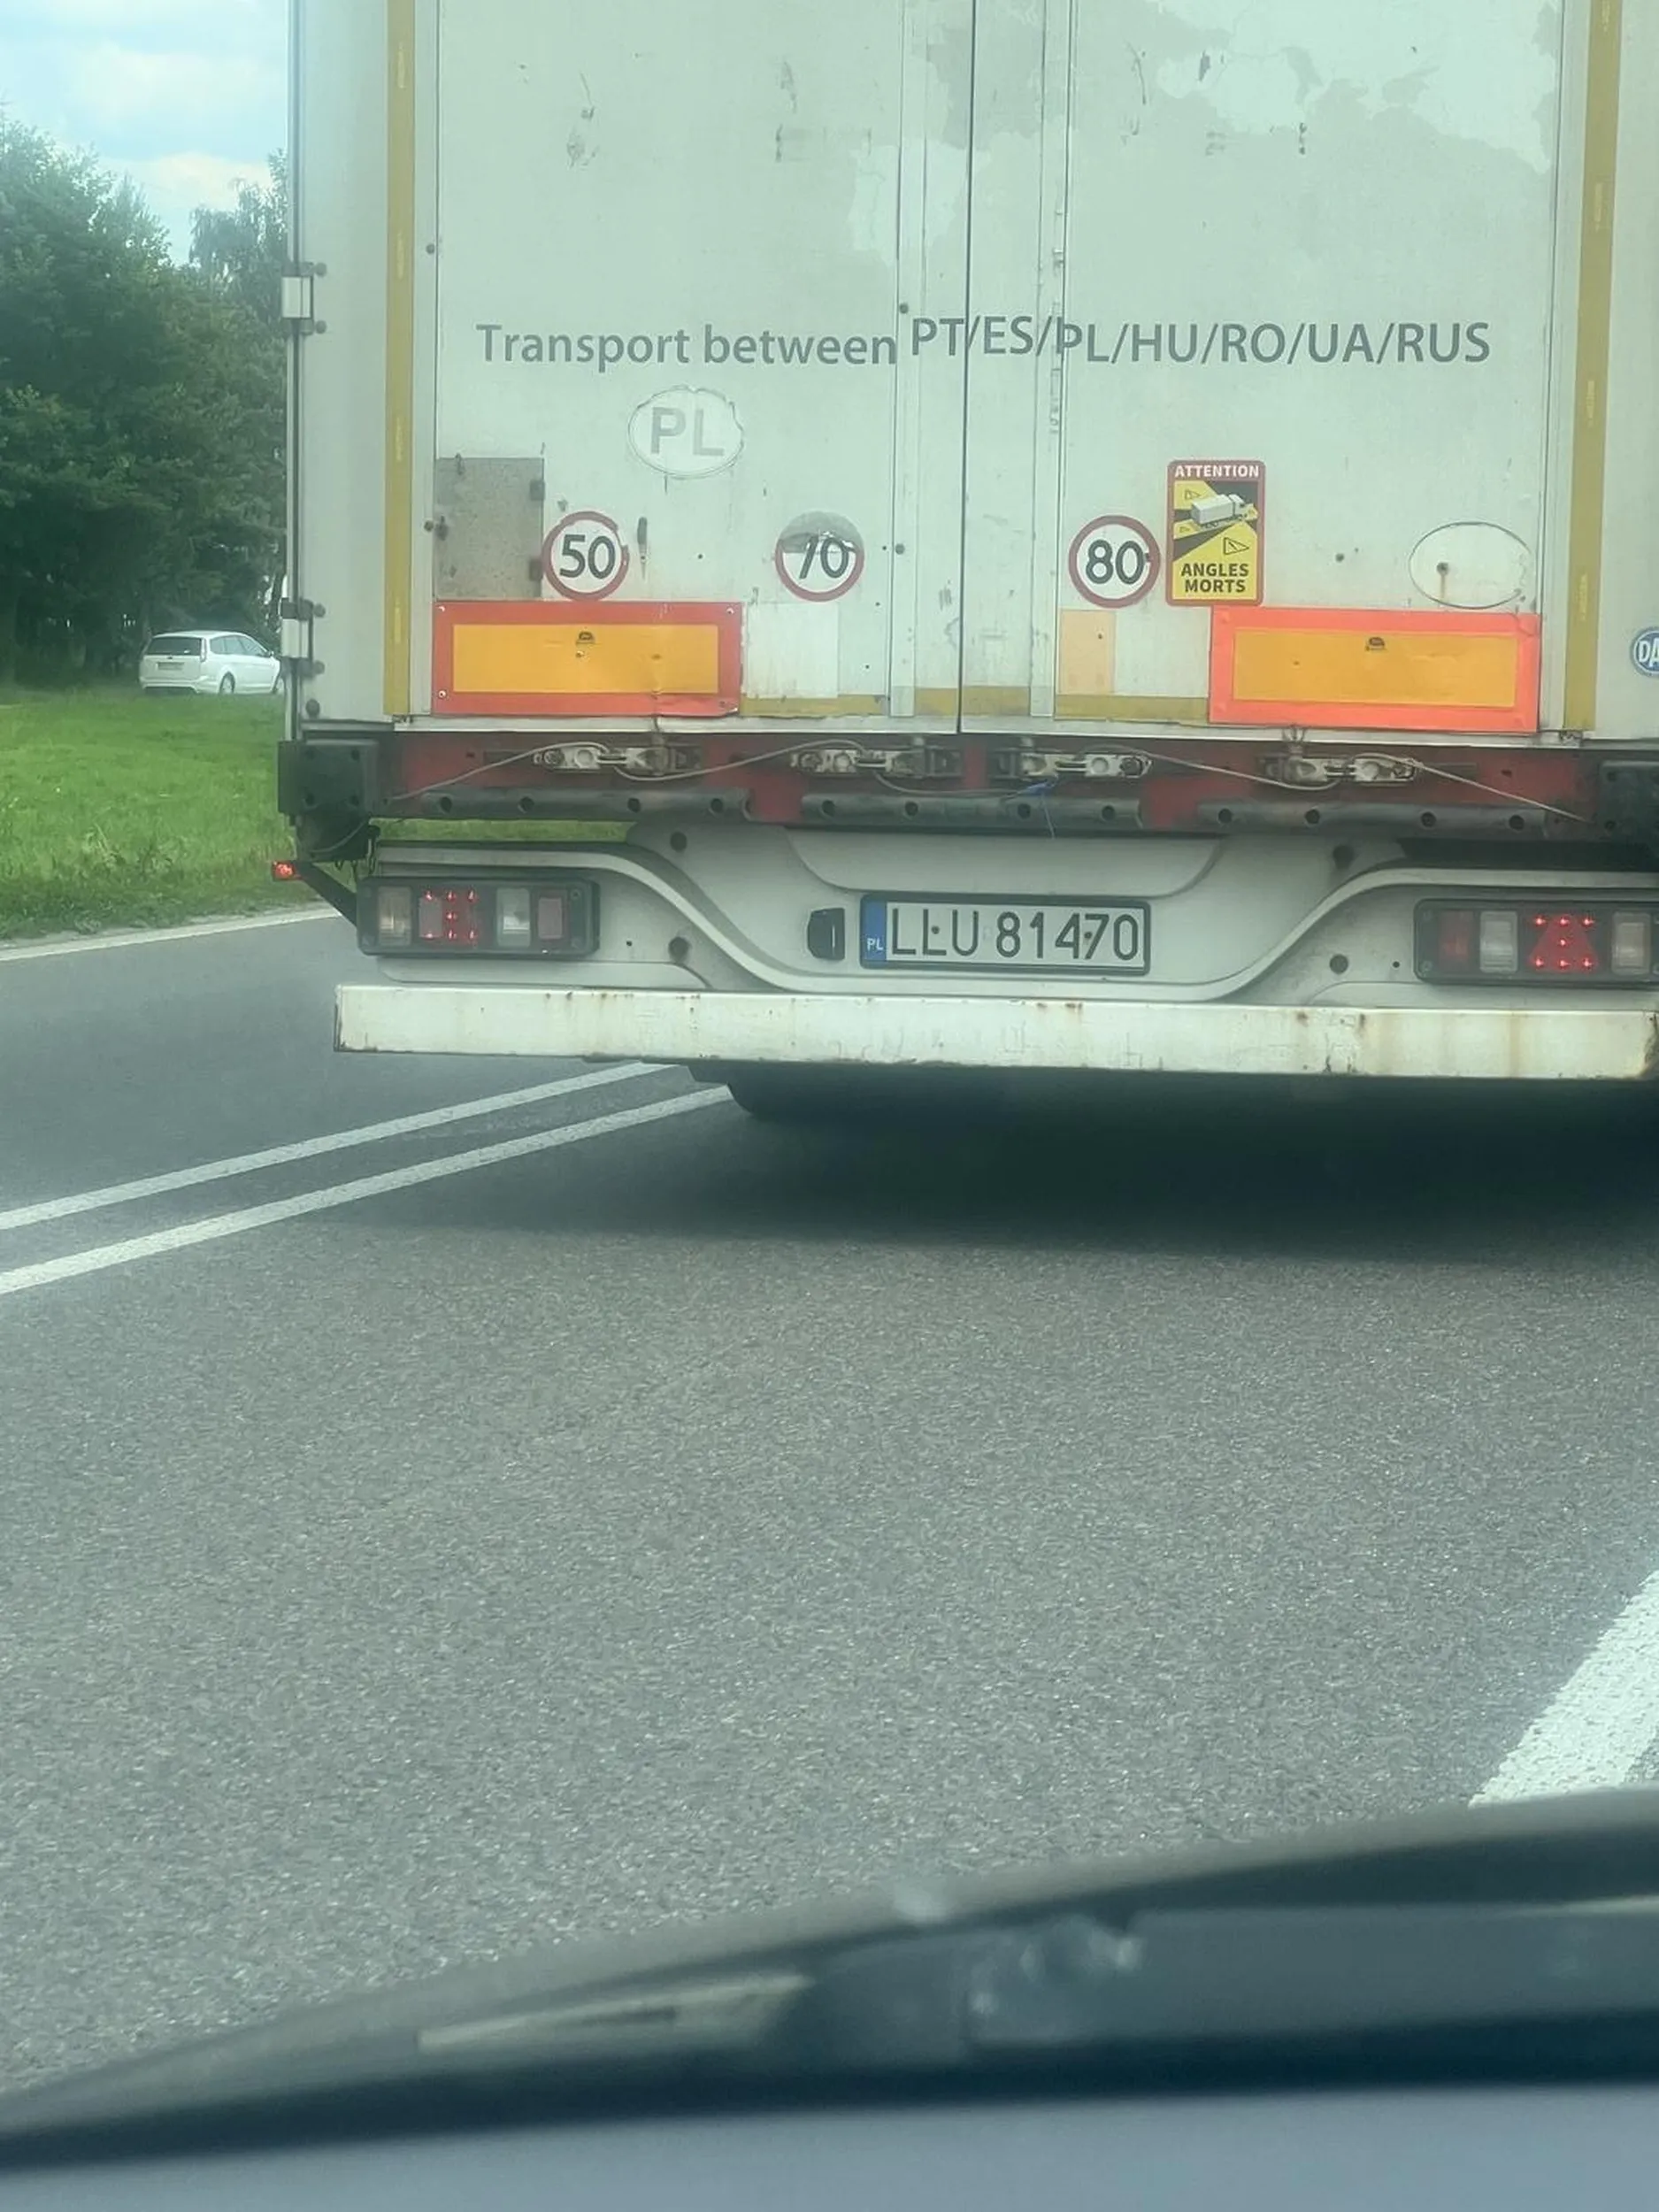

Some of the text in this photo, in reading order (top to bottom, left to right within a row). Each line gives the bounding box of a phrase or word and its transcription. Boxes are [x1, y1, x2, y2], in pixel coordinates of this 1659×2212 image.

[476, 315, 1491, 373] Transport between PT/ES/PL/HU/RO/UA/RUS
[650, 406, 725, 457] PL
[1174, 465, 1259, 478] ATTENTION
[559, 534, 617, 580] 50
[797, 534, 849, 580] 70
[1086, 539, 1145, 585] 80
[1181, 563, 1249, 577] ANGLES
[1185, 579, 1246, 593] MORTS
[867, 937, 884, 951] PL
[892, 908, 1139, 960] LLU 81470
